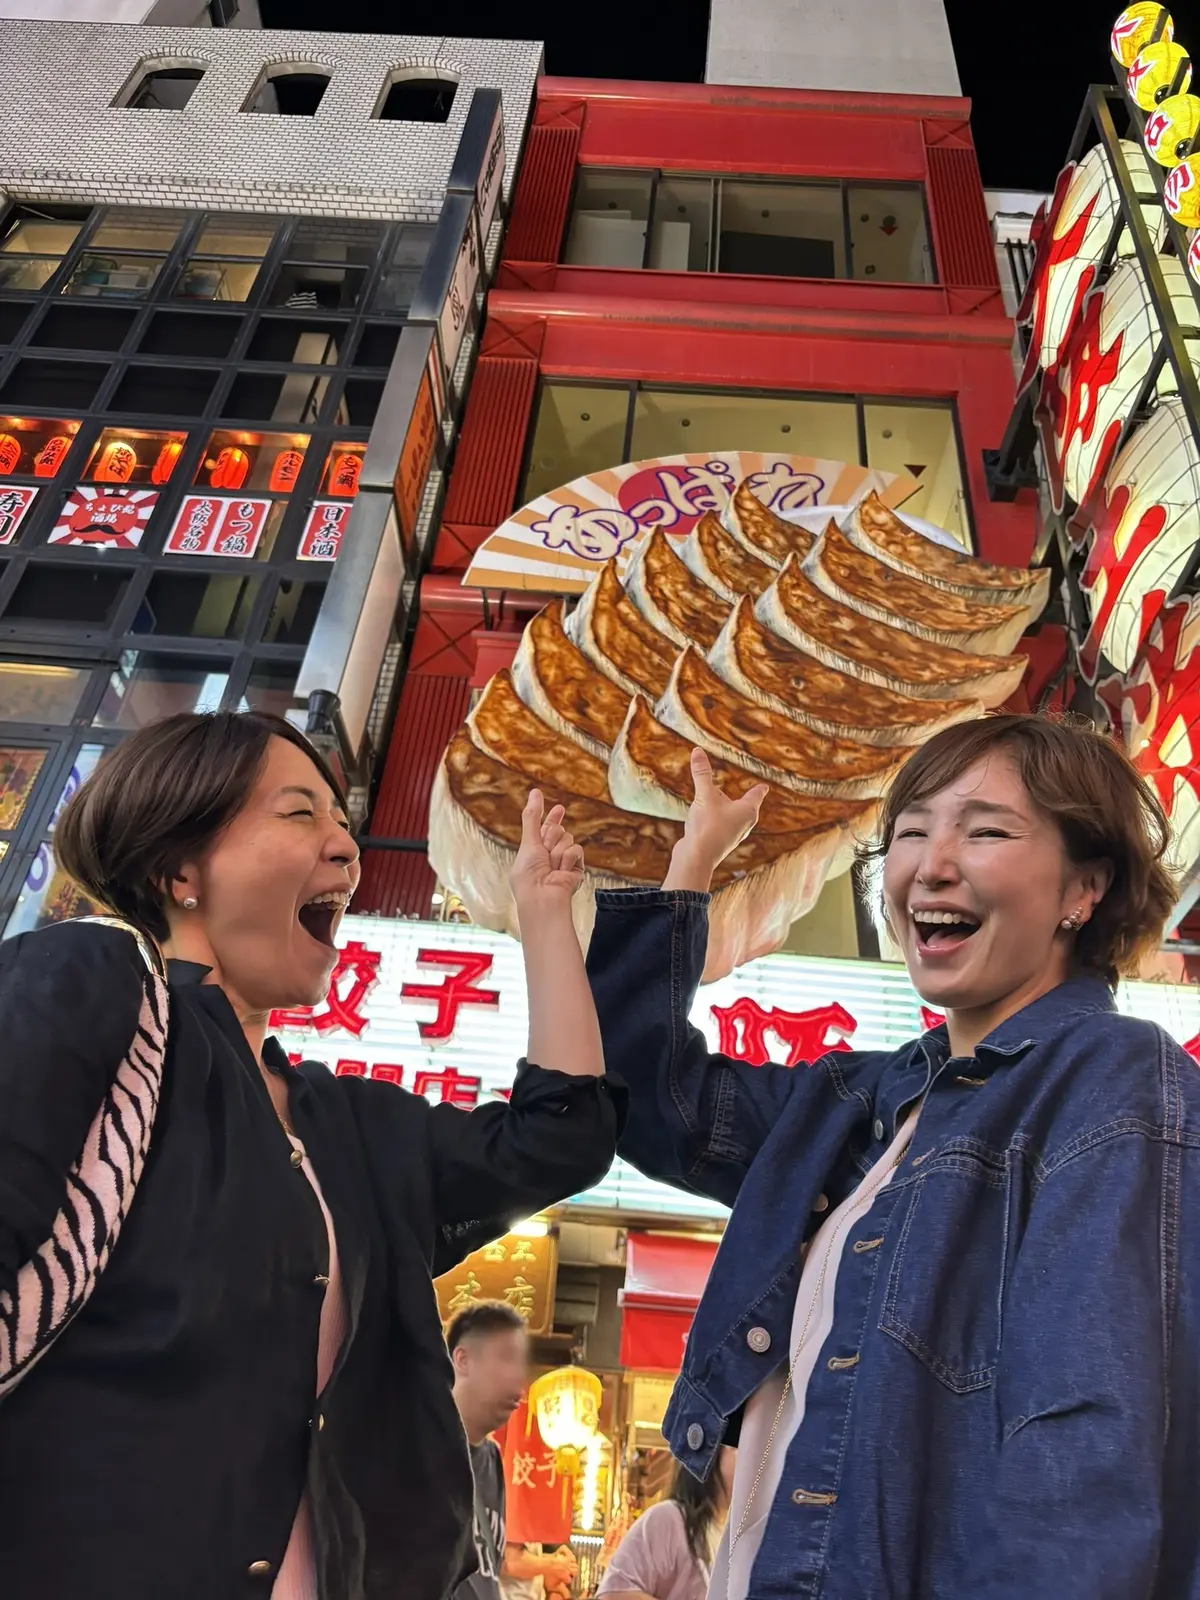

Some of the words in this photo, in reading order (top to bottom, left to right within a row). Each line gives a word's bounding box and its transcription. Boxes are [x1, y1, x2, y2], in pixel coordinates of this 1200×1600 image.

[179, 501, 213, 551] 大阪名物
[222, 503, 254, 553] もつ鍋
[310, 507, 344, 556] 日本酒
[512, 1451, 558, 1488] 餃子
